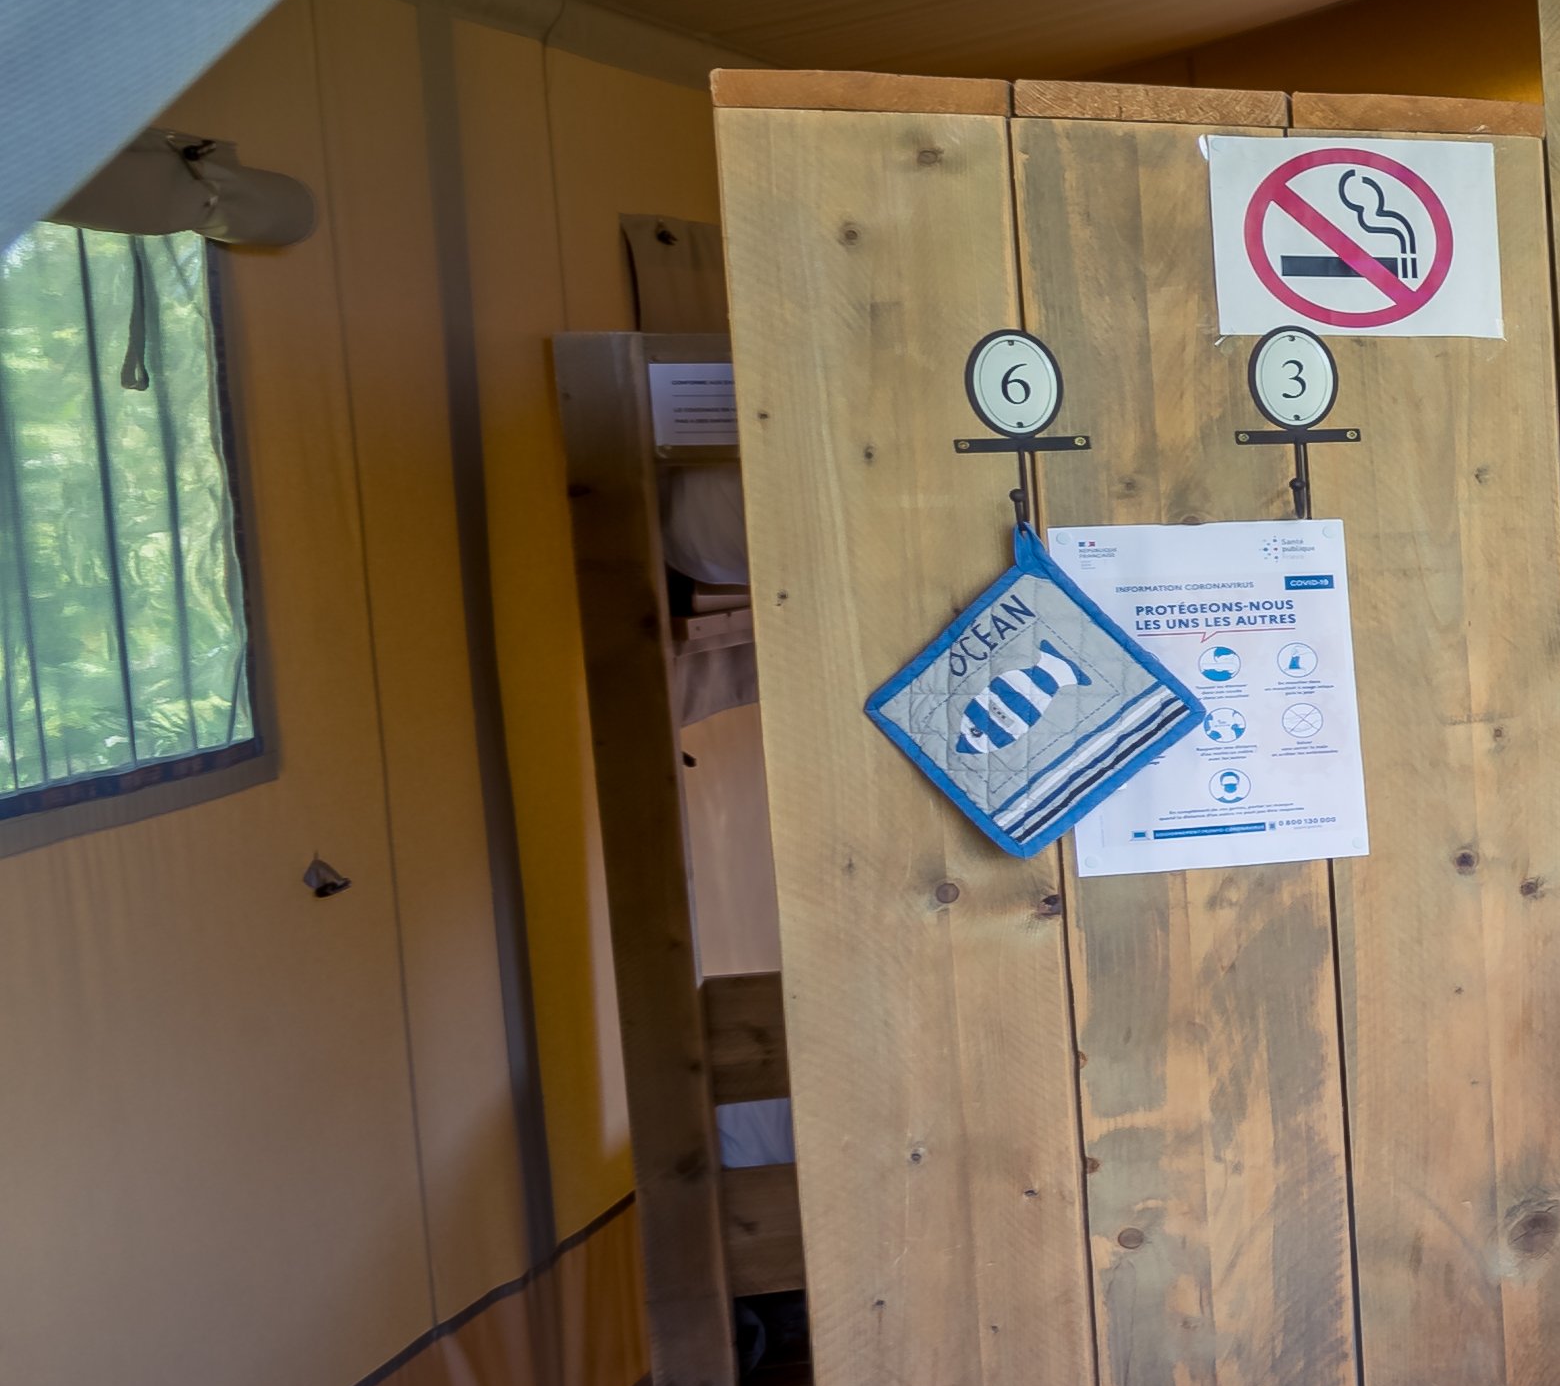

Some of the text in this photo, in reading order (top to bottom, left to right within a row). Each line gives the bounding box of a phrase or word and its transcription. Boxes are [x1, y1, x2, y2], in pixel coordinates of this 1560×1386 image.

[1001, 363, 1031, 405] 6
[1281, 359, 1307, 399] 3
[1115, 581, 1255, 594] INFORMATION CORONAVIRUS
[1135, 599, 1295, 617] PROTÉGEONS-NOUS
[1135, 613, 1297, 631] LES UNS LES AUTRES
